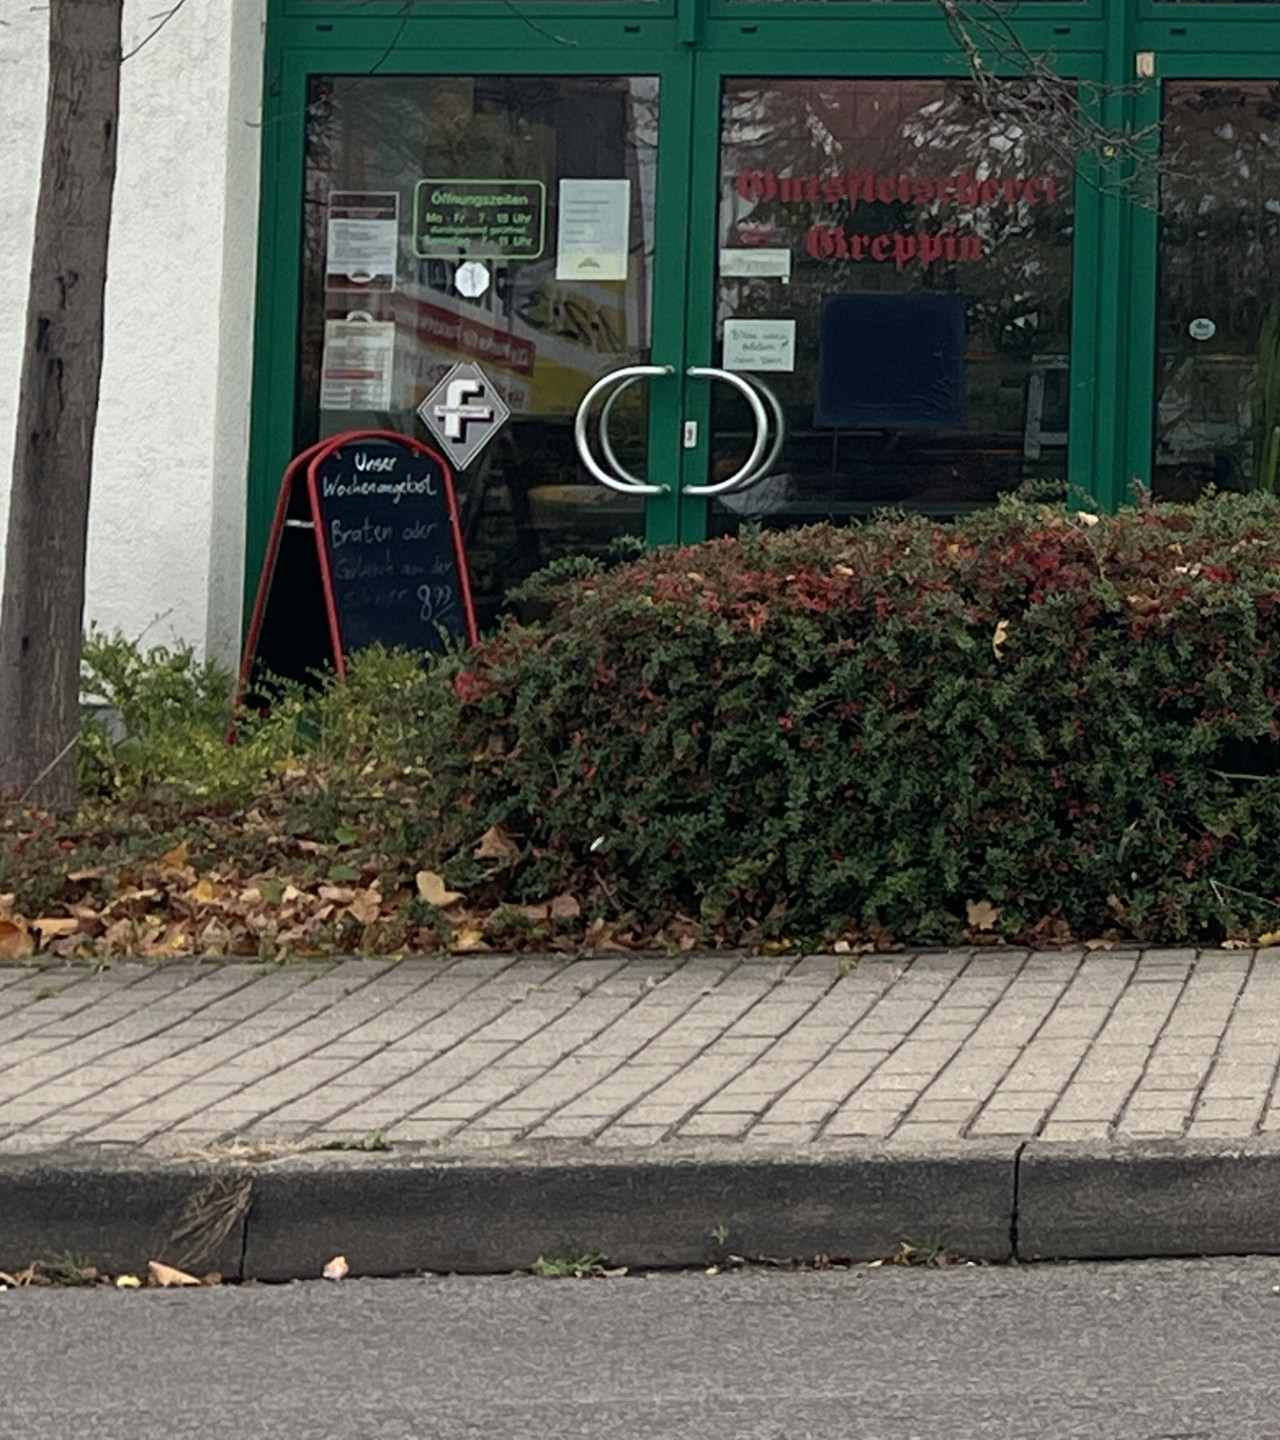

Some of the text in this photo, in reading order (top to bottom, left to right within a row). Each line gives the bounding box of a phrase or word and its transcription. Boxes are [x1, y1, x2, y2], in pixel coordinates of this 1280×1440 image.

[431, 190, 529, 207] Öffnungszeiten
[735, 167, 1059, 213] Gutsfleischerei
[805, 223, 985, 272] Greppin
[354, 452, 398, 472] Unser
[322, 474, 437, 504] Wochenangebot
[331, 516, 438, 549] Braten oder
